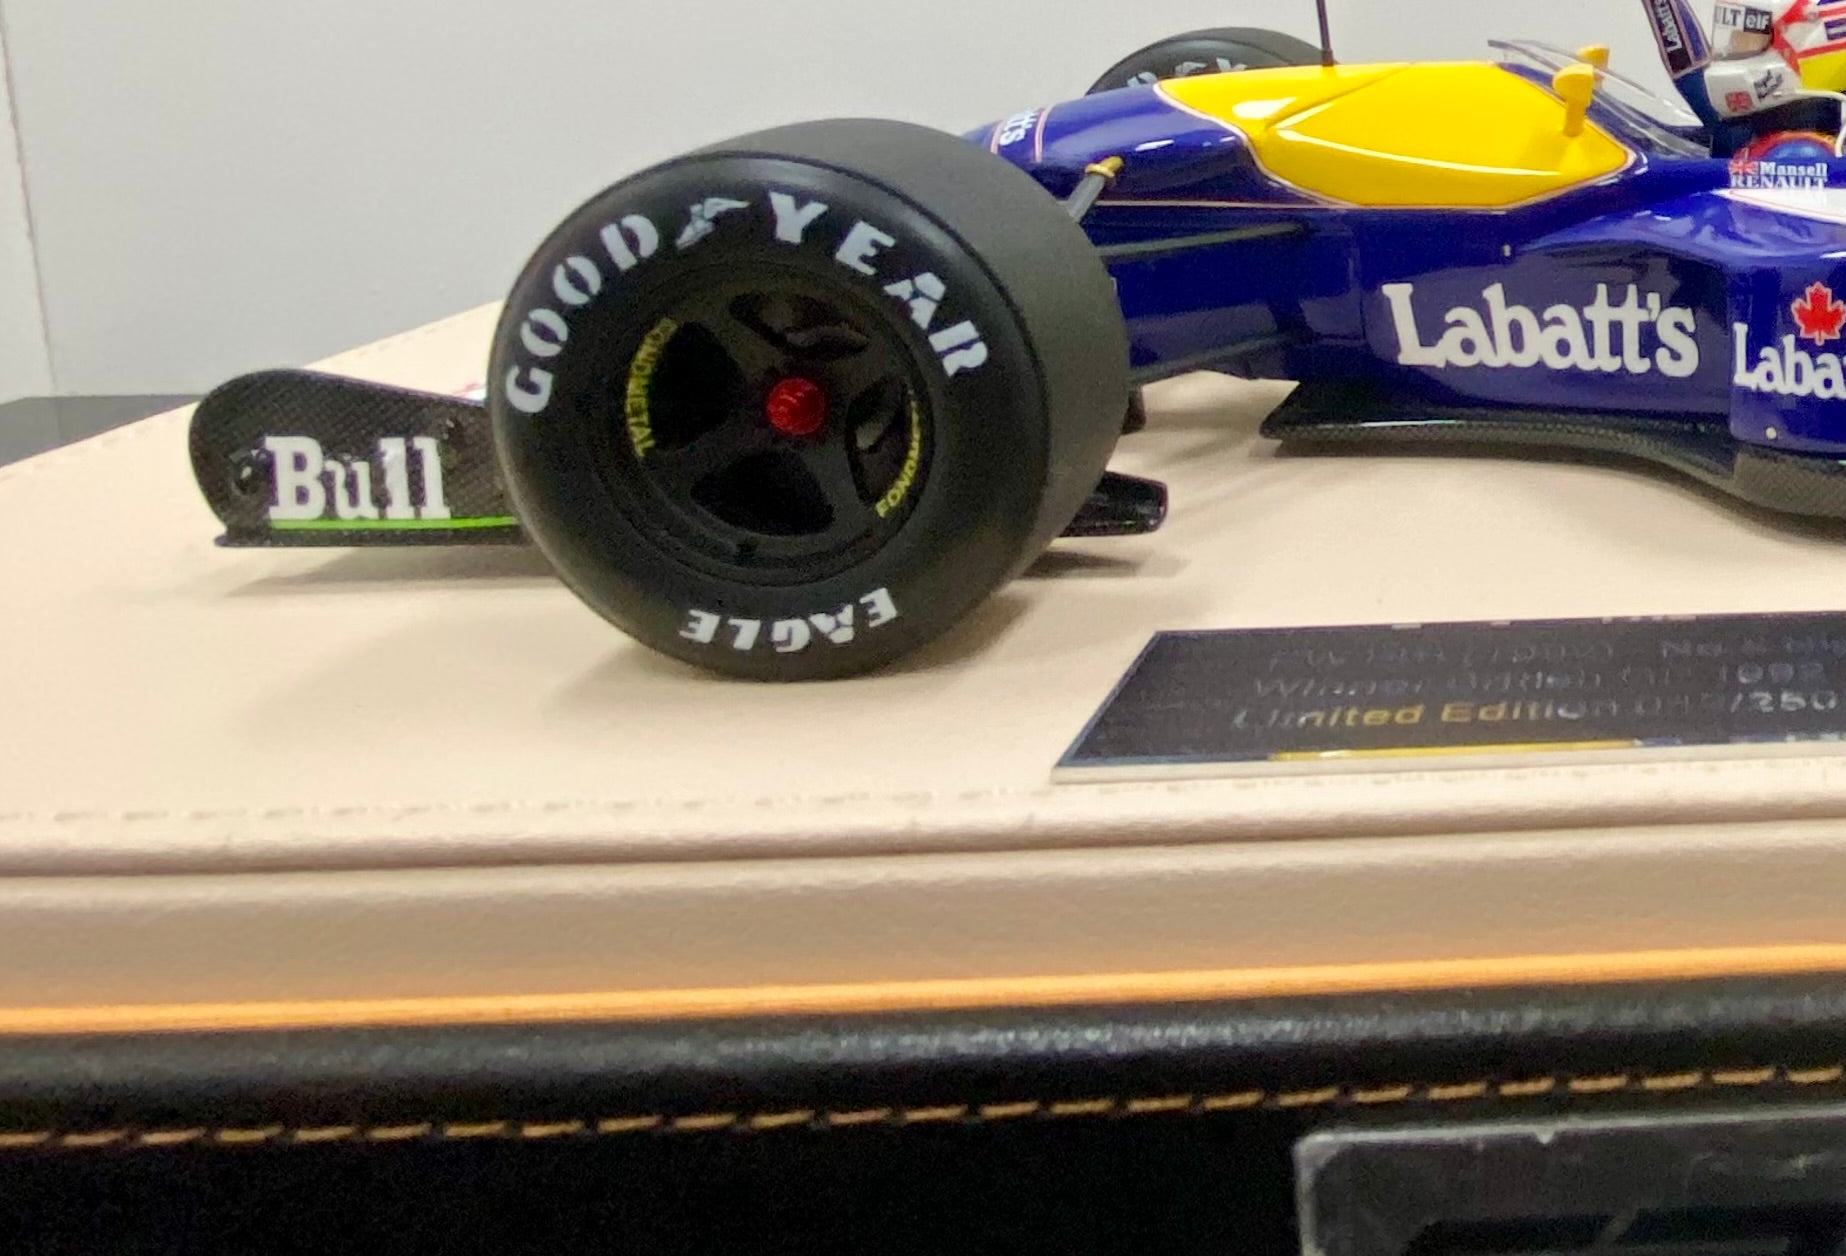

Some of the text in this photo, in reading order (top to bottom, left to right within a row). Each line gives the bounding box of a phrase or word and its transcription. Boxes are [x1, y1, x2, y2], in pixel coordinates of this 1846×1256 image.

[1745, 11, 1770, 31] elf
[1730, 175, 1828, 190] RENAULT
[1760, 161, 1828, 176] Mansell
[1382, 282, 1699, 378] Labatt's
[265, 435, 451, 520] Bull
[679, 587, 899, 653] EAGLE
